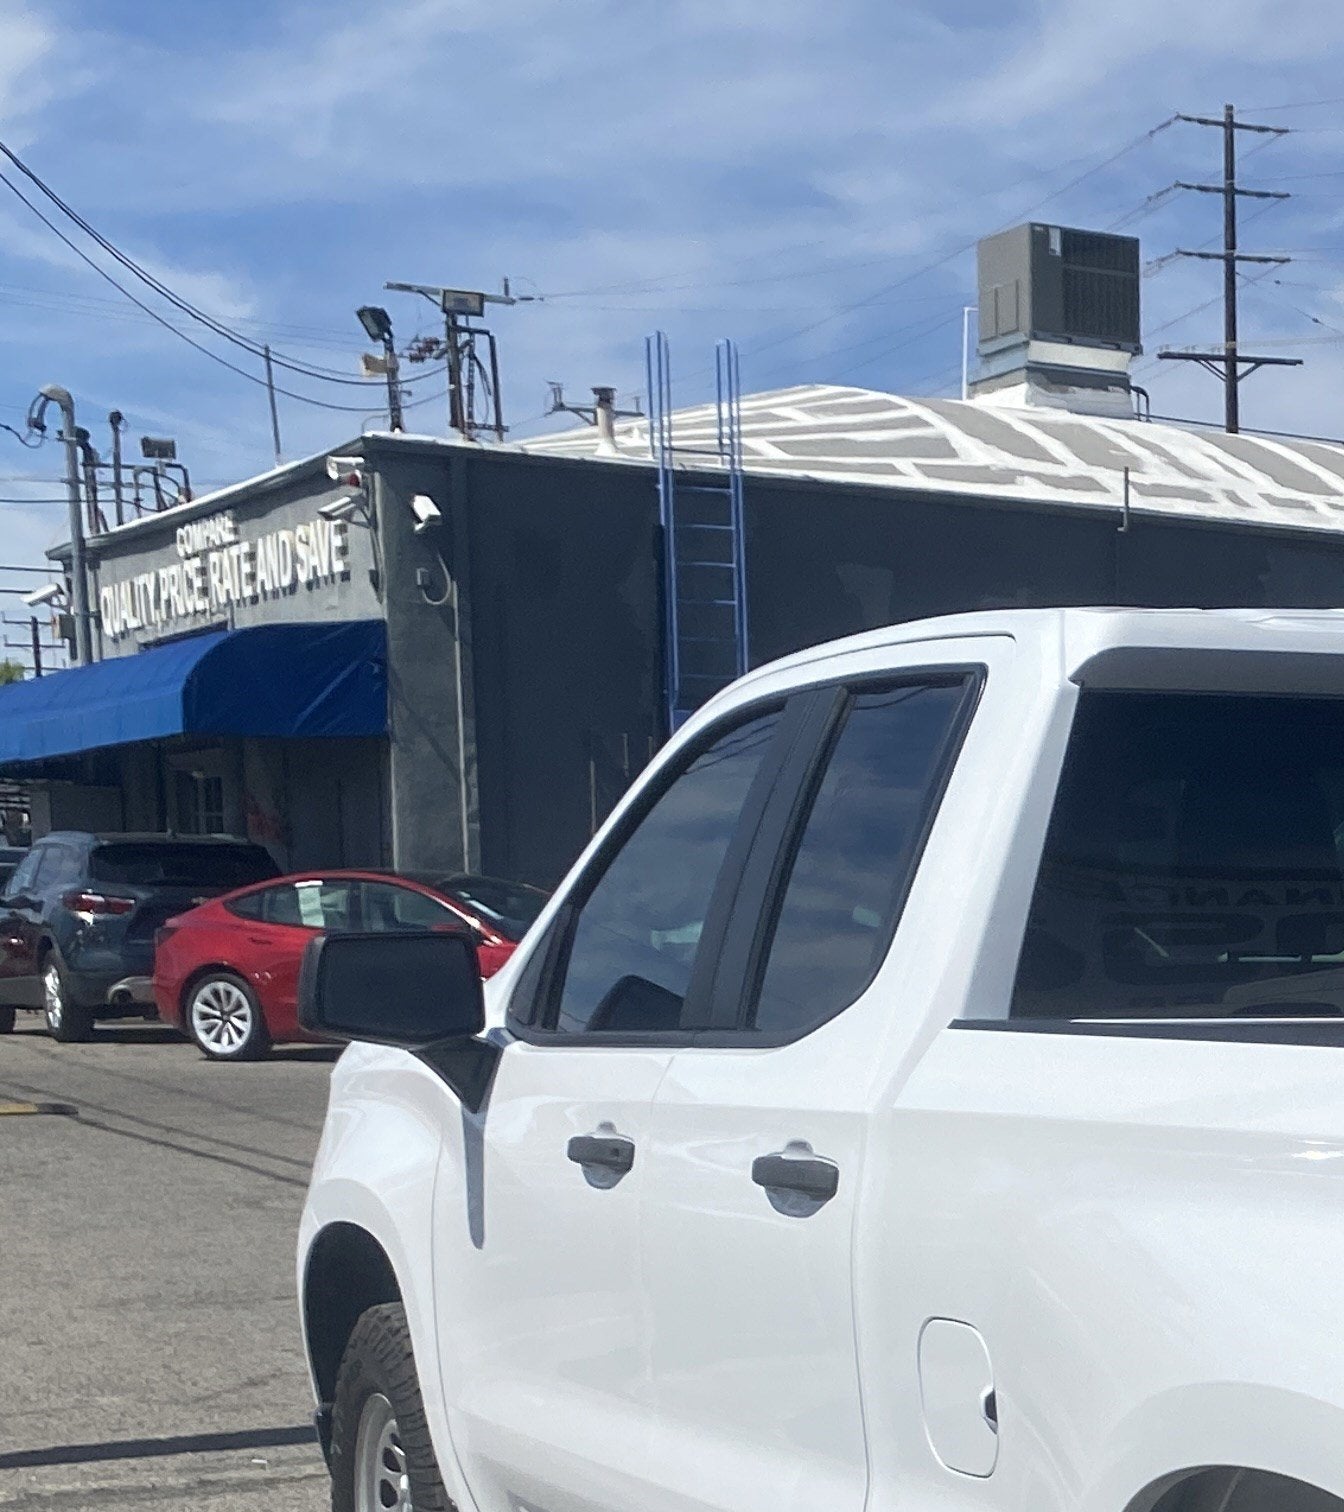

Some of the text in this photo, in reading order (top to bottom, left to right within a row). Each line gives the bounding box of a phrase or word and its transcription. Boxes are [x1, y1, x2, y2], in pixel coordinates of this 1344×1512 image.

[209, 543, 253, 605] RATE
[257, 530, 292, 594] AND
[296, 519, 345, 583] SAVE
